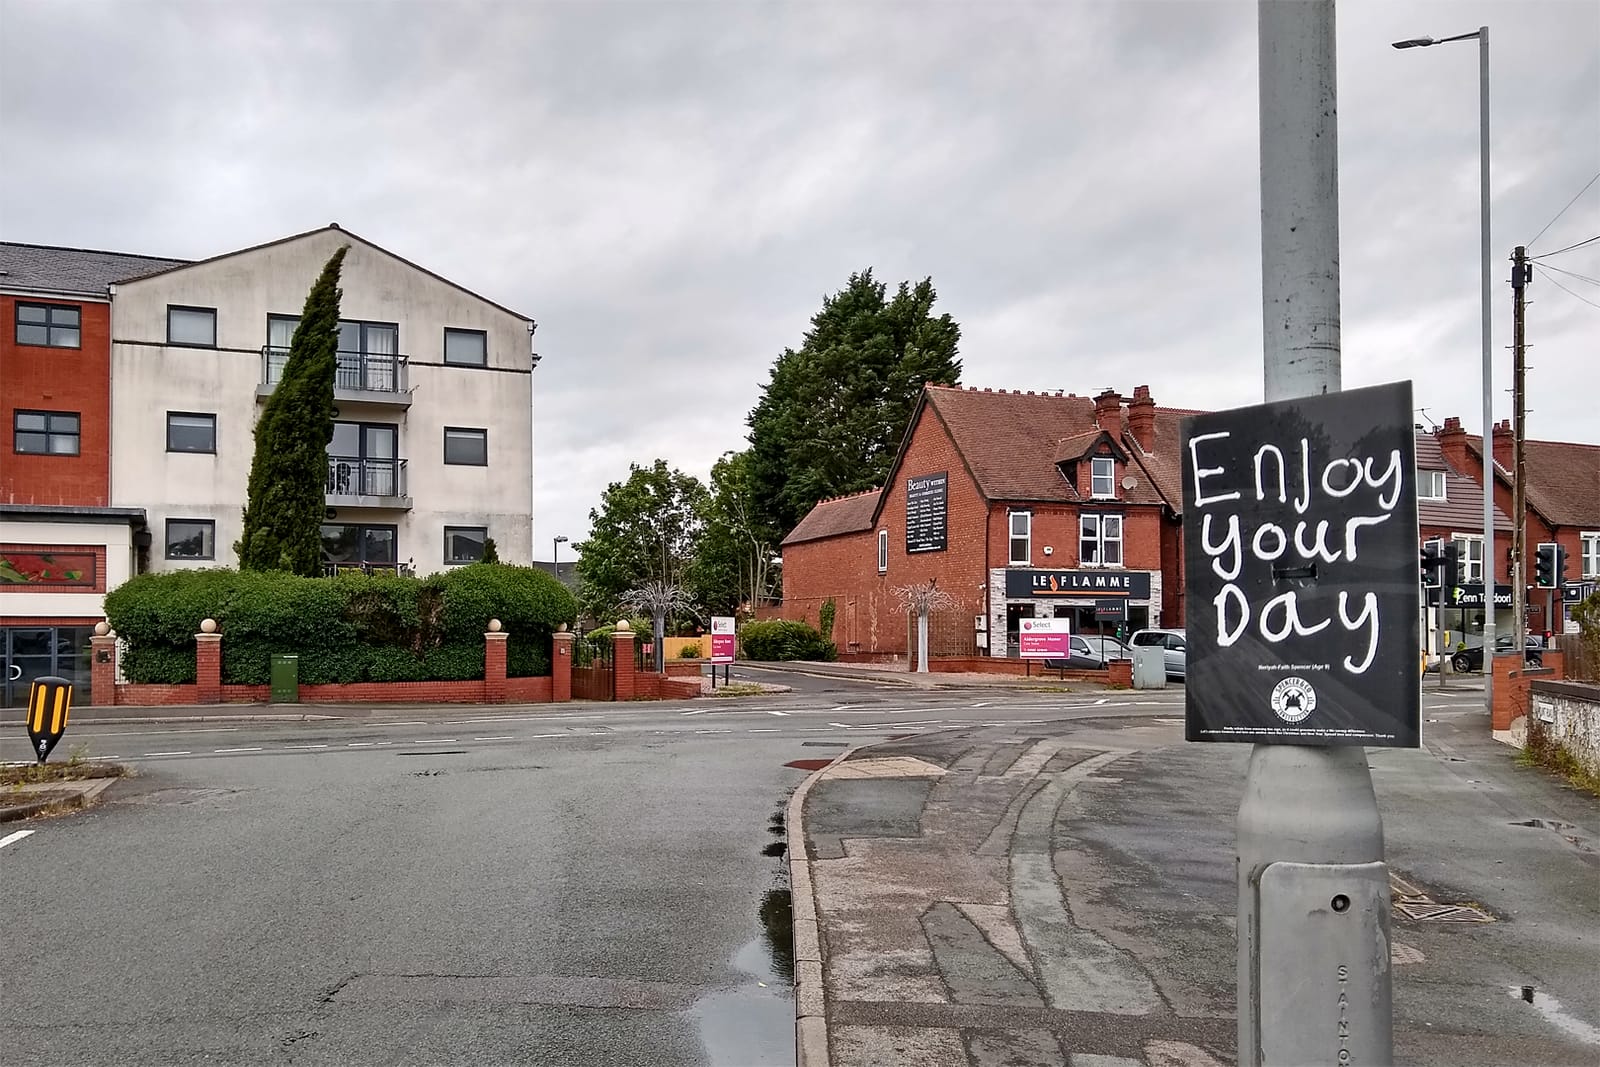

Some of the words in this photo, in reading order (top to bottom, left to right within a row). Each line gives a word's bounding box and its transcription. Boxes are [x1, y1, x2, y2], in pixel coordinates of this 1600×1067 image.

[908, 480, 930, 491] Beauty
[1033, 575, 1047, 587] LE
[1061, 575, 1131, 588] FLAMME
[1455, 587, 1478, 605] Penn
[1479, 592, 1511, 603] Tdoori
[1214, 583, 1380, 675] Day
